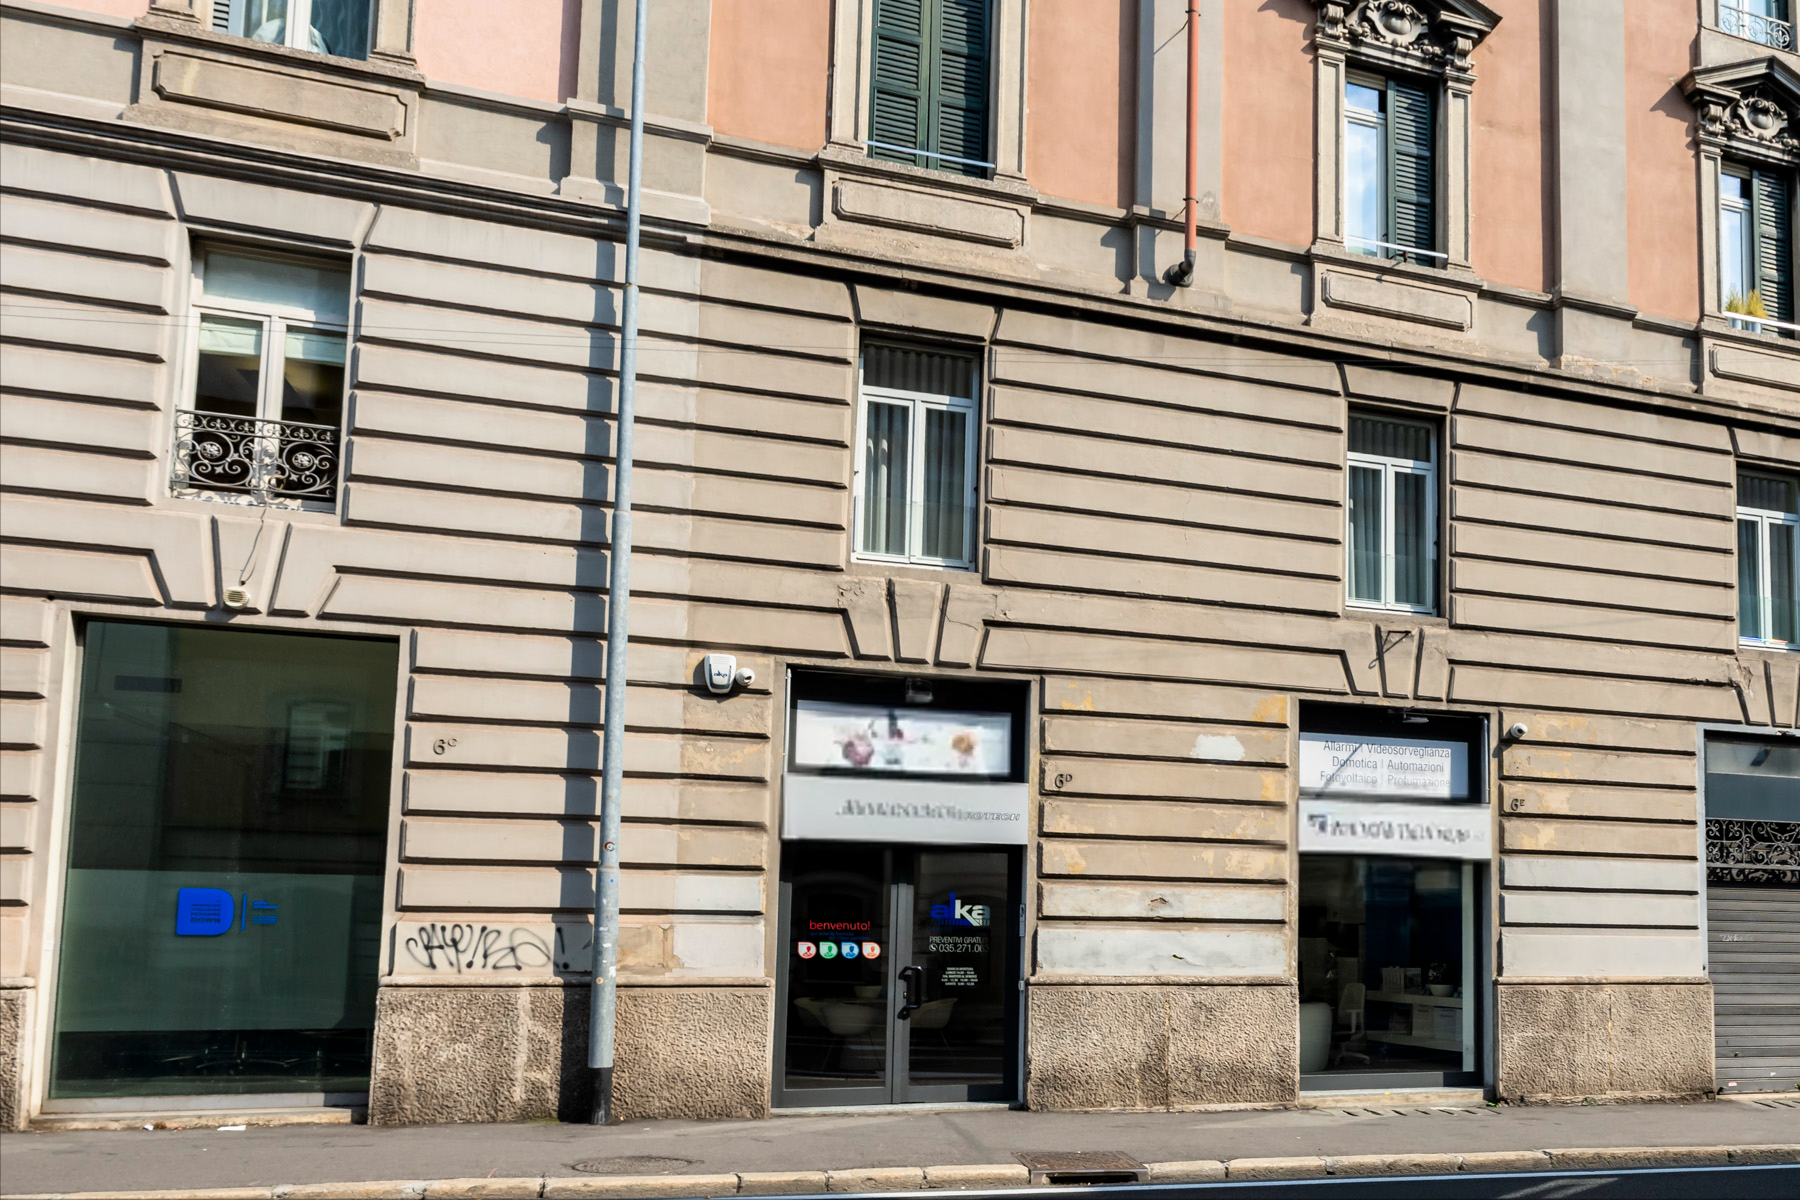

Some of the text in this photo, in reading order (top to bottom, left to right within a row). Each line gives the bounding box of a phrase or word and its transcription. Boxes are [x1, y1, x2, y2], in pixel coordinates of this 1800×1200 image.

[1323, 740, 1450, 758] Allarmi Videosorveglianza
[1332, 756, 1445, 773] Domotica Automazioni
[1320, 770, 1451, 788] Fotovoltaico Profumazione
[809, 919, 871, 931] benvenuto!
